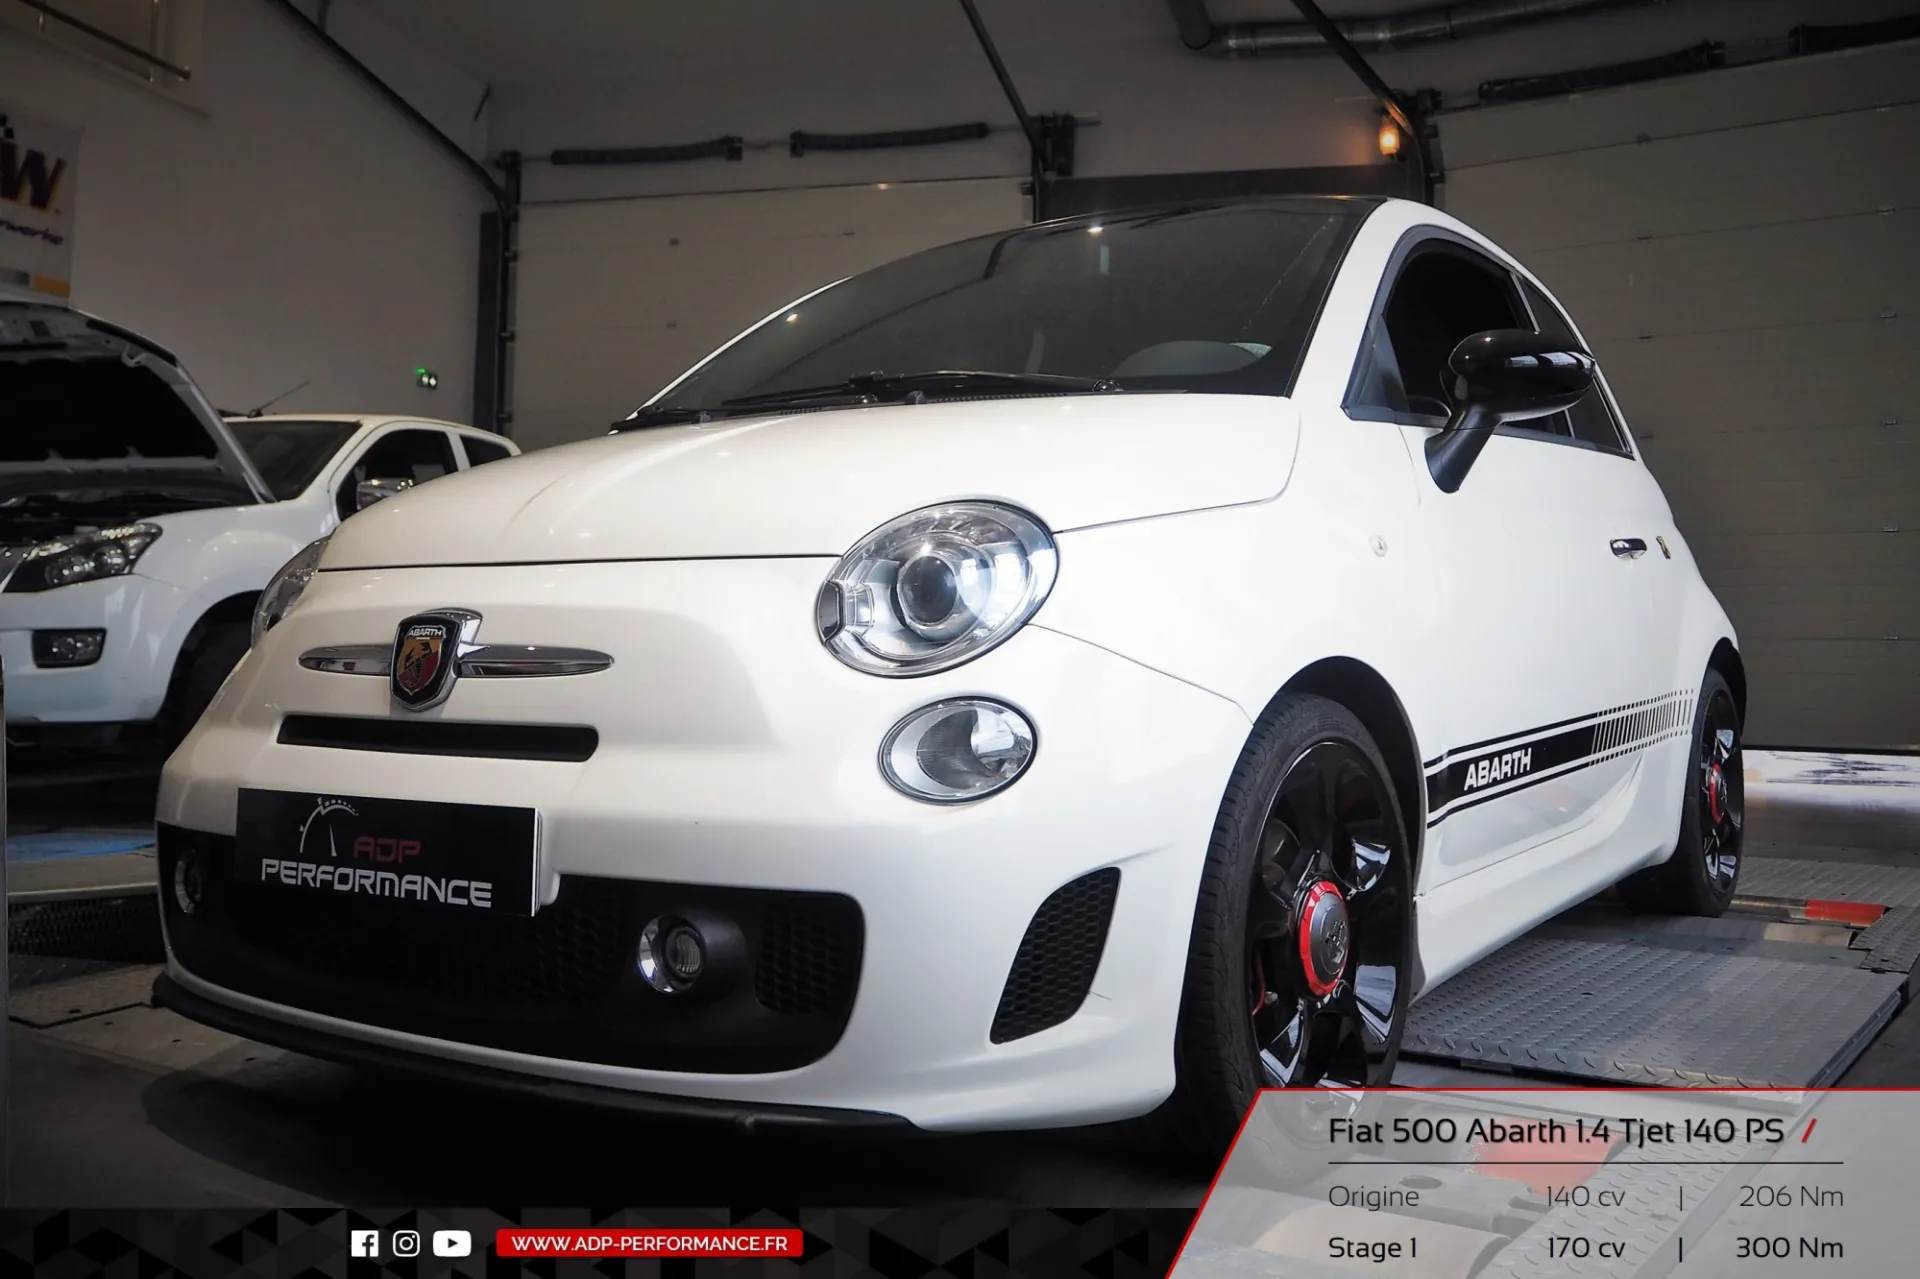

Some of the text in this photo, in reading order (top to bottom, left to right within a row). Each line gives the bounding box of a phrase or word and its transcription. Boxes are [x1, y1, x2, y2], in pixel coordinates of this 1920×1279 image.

[408, 627, 443, 637] ABARTH
[1463, 747, 1532, 791] ABARTH
[353, 835, 421, 864] ADP
[261, 857, 492, 909] PERFORMANCE
